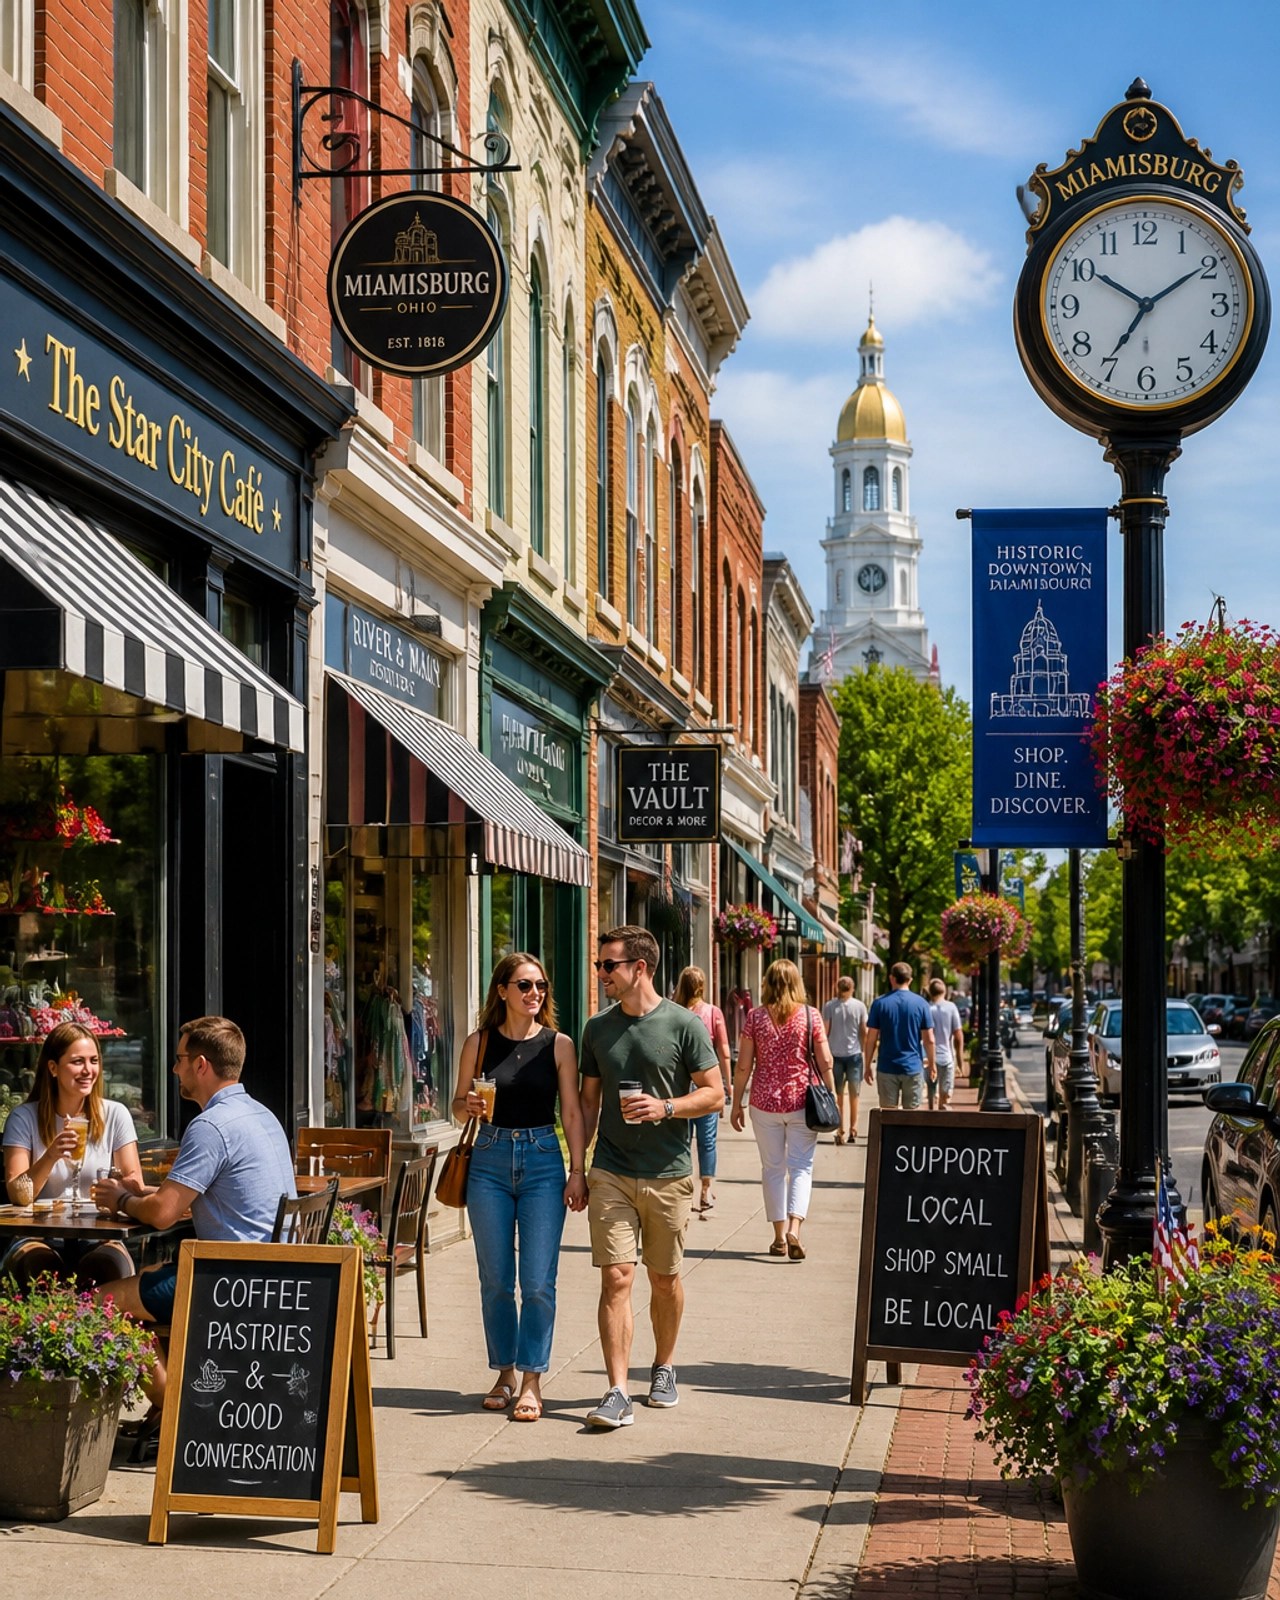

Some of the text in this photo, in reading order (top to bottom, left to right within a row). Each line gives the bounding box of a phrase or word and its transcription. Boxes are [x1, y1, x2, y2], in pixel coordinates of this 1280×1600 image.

[1055, 152, 1223, 201] MIAMISBURG
[1099, 231, 1119, 256] 11
[1132, 220, 1158, 245] 12
[1177, 230, 1186, 254] 1
[1071, 257, 1095, 282] 10
[1200, 255, 1218, 280] 2
[344, 271, 490, 297] MIAMISBURG
[397, 302, 437, 314] OHIO
[1060, 293, 1080, 319] 9
[1210, 293, 1230, 317] 3
[387, 336, 445, 349] EST. 1818
[1072, 330, 1092, 357] 8
[1199, 329, 1219, 354] 4
[1100, 356, 1119, 382] 7
[1137, 366, 1156, 392] 6
[1176, 356, 1193, 382] 5
[44, 333, 265, 535] The Star City Café
[997, 545, 1083, 560] HISTORIC
[988, 562, 1092, 576] DOWNTOWN
[1013, 747, 1068, 764] SHOP.
[647, 762, 690, 782] THE
[1014, 772, 1066, 789] DINE.
[627, 786, 709, 810] VAULT
[990, 797, 1091, 814] DISCOVER.
[629, 816, 707, 826] DECOR & MORE
[894, 1145, 1009, 1176] SUPPORT
[906, 1195, 993, 1226] LOCAL
[884, 1248, 1009, 1277] SHOP SMALL
[213, 1277, 312, 1311] COFFEE
[884, 1298, 1000, 1331] BE LOCAL
[207, 1321, 312, 1353] PASTRIES
[245, 1360, 265, 1390] &
[218, 1400, 283, 1430] GOOD
[183, 1440, 317, 1472] CONVERSATION
